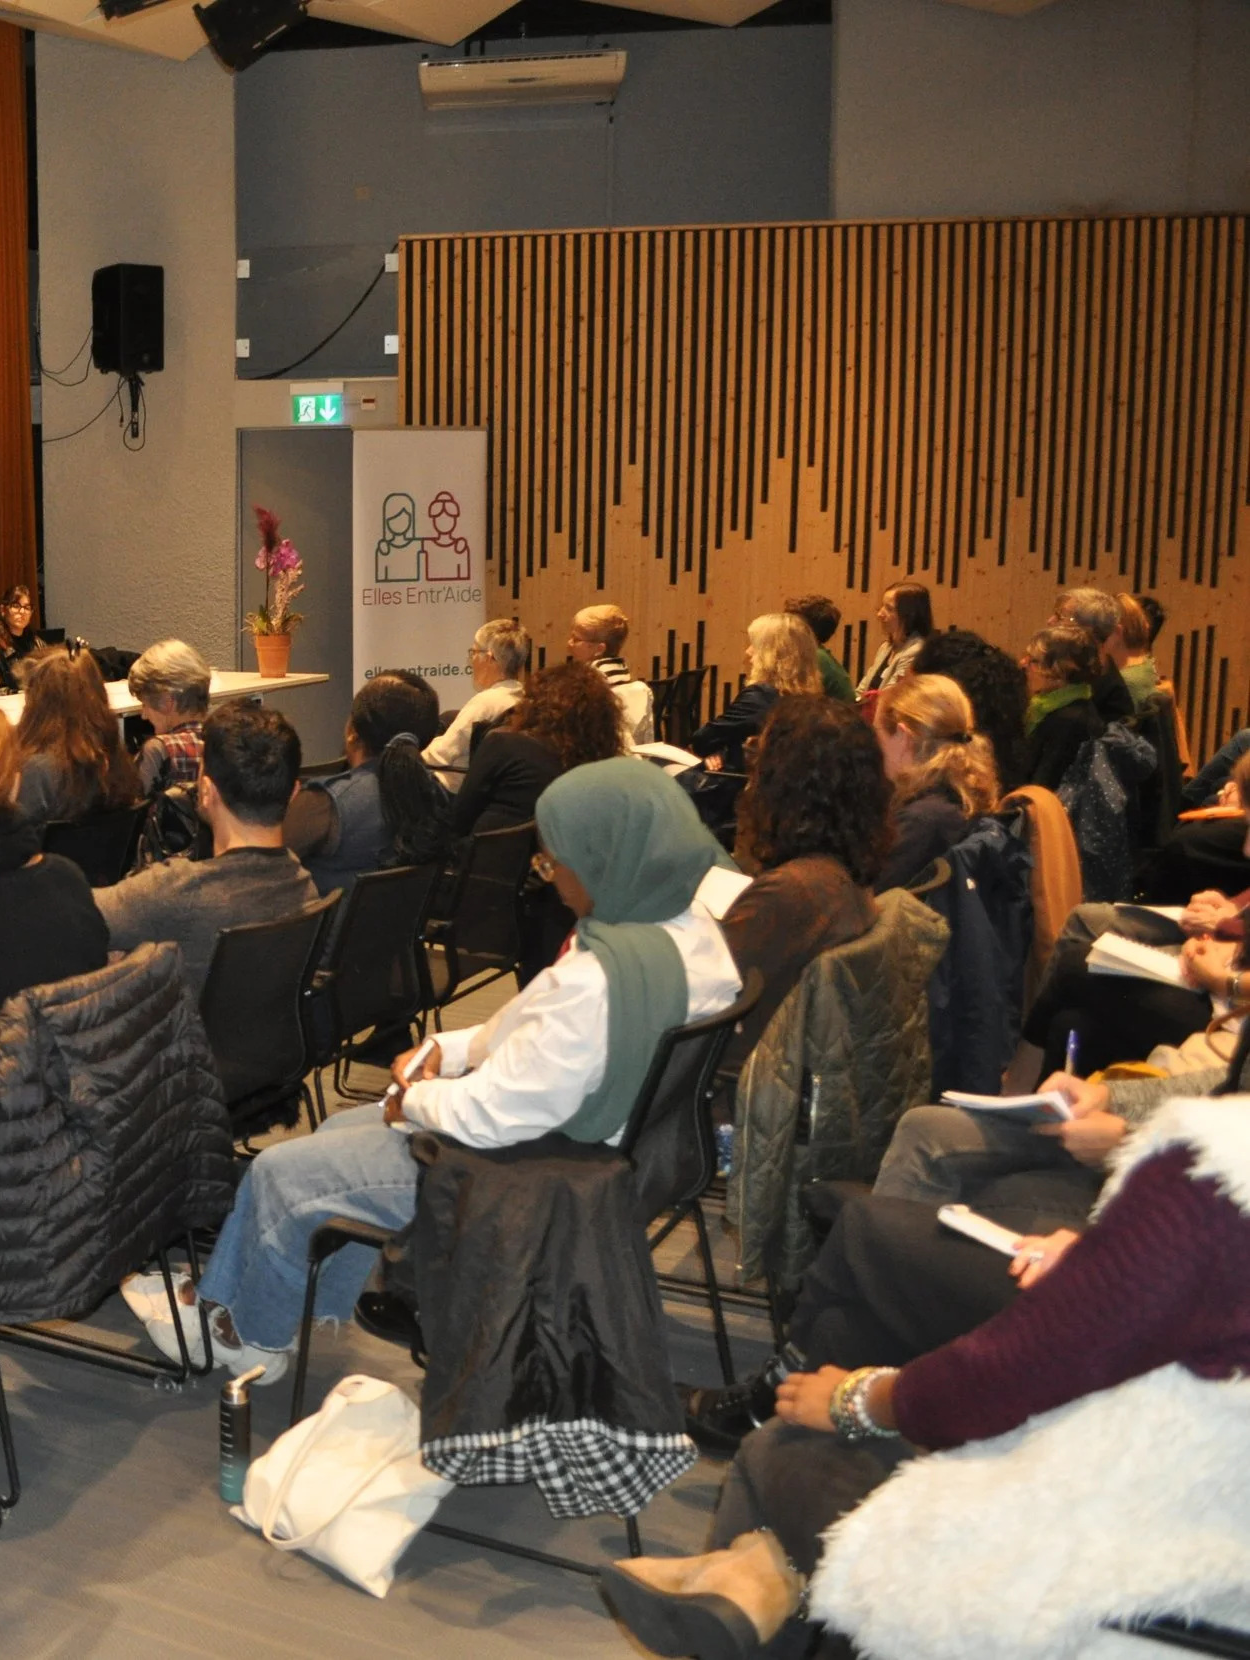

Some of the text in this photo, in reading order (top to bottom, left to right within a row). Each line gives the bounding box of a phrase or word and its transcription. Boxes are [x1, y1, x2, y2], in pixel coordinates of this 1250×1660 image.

[362, 586, 482, 606] Elles Entr'Aide
[364, 663, 473, 680] ellntraide.c
